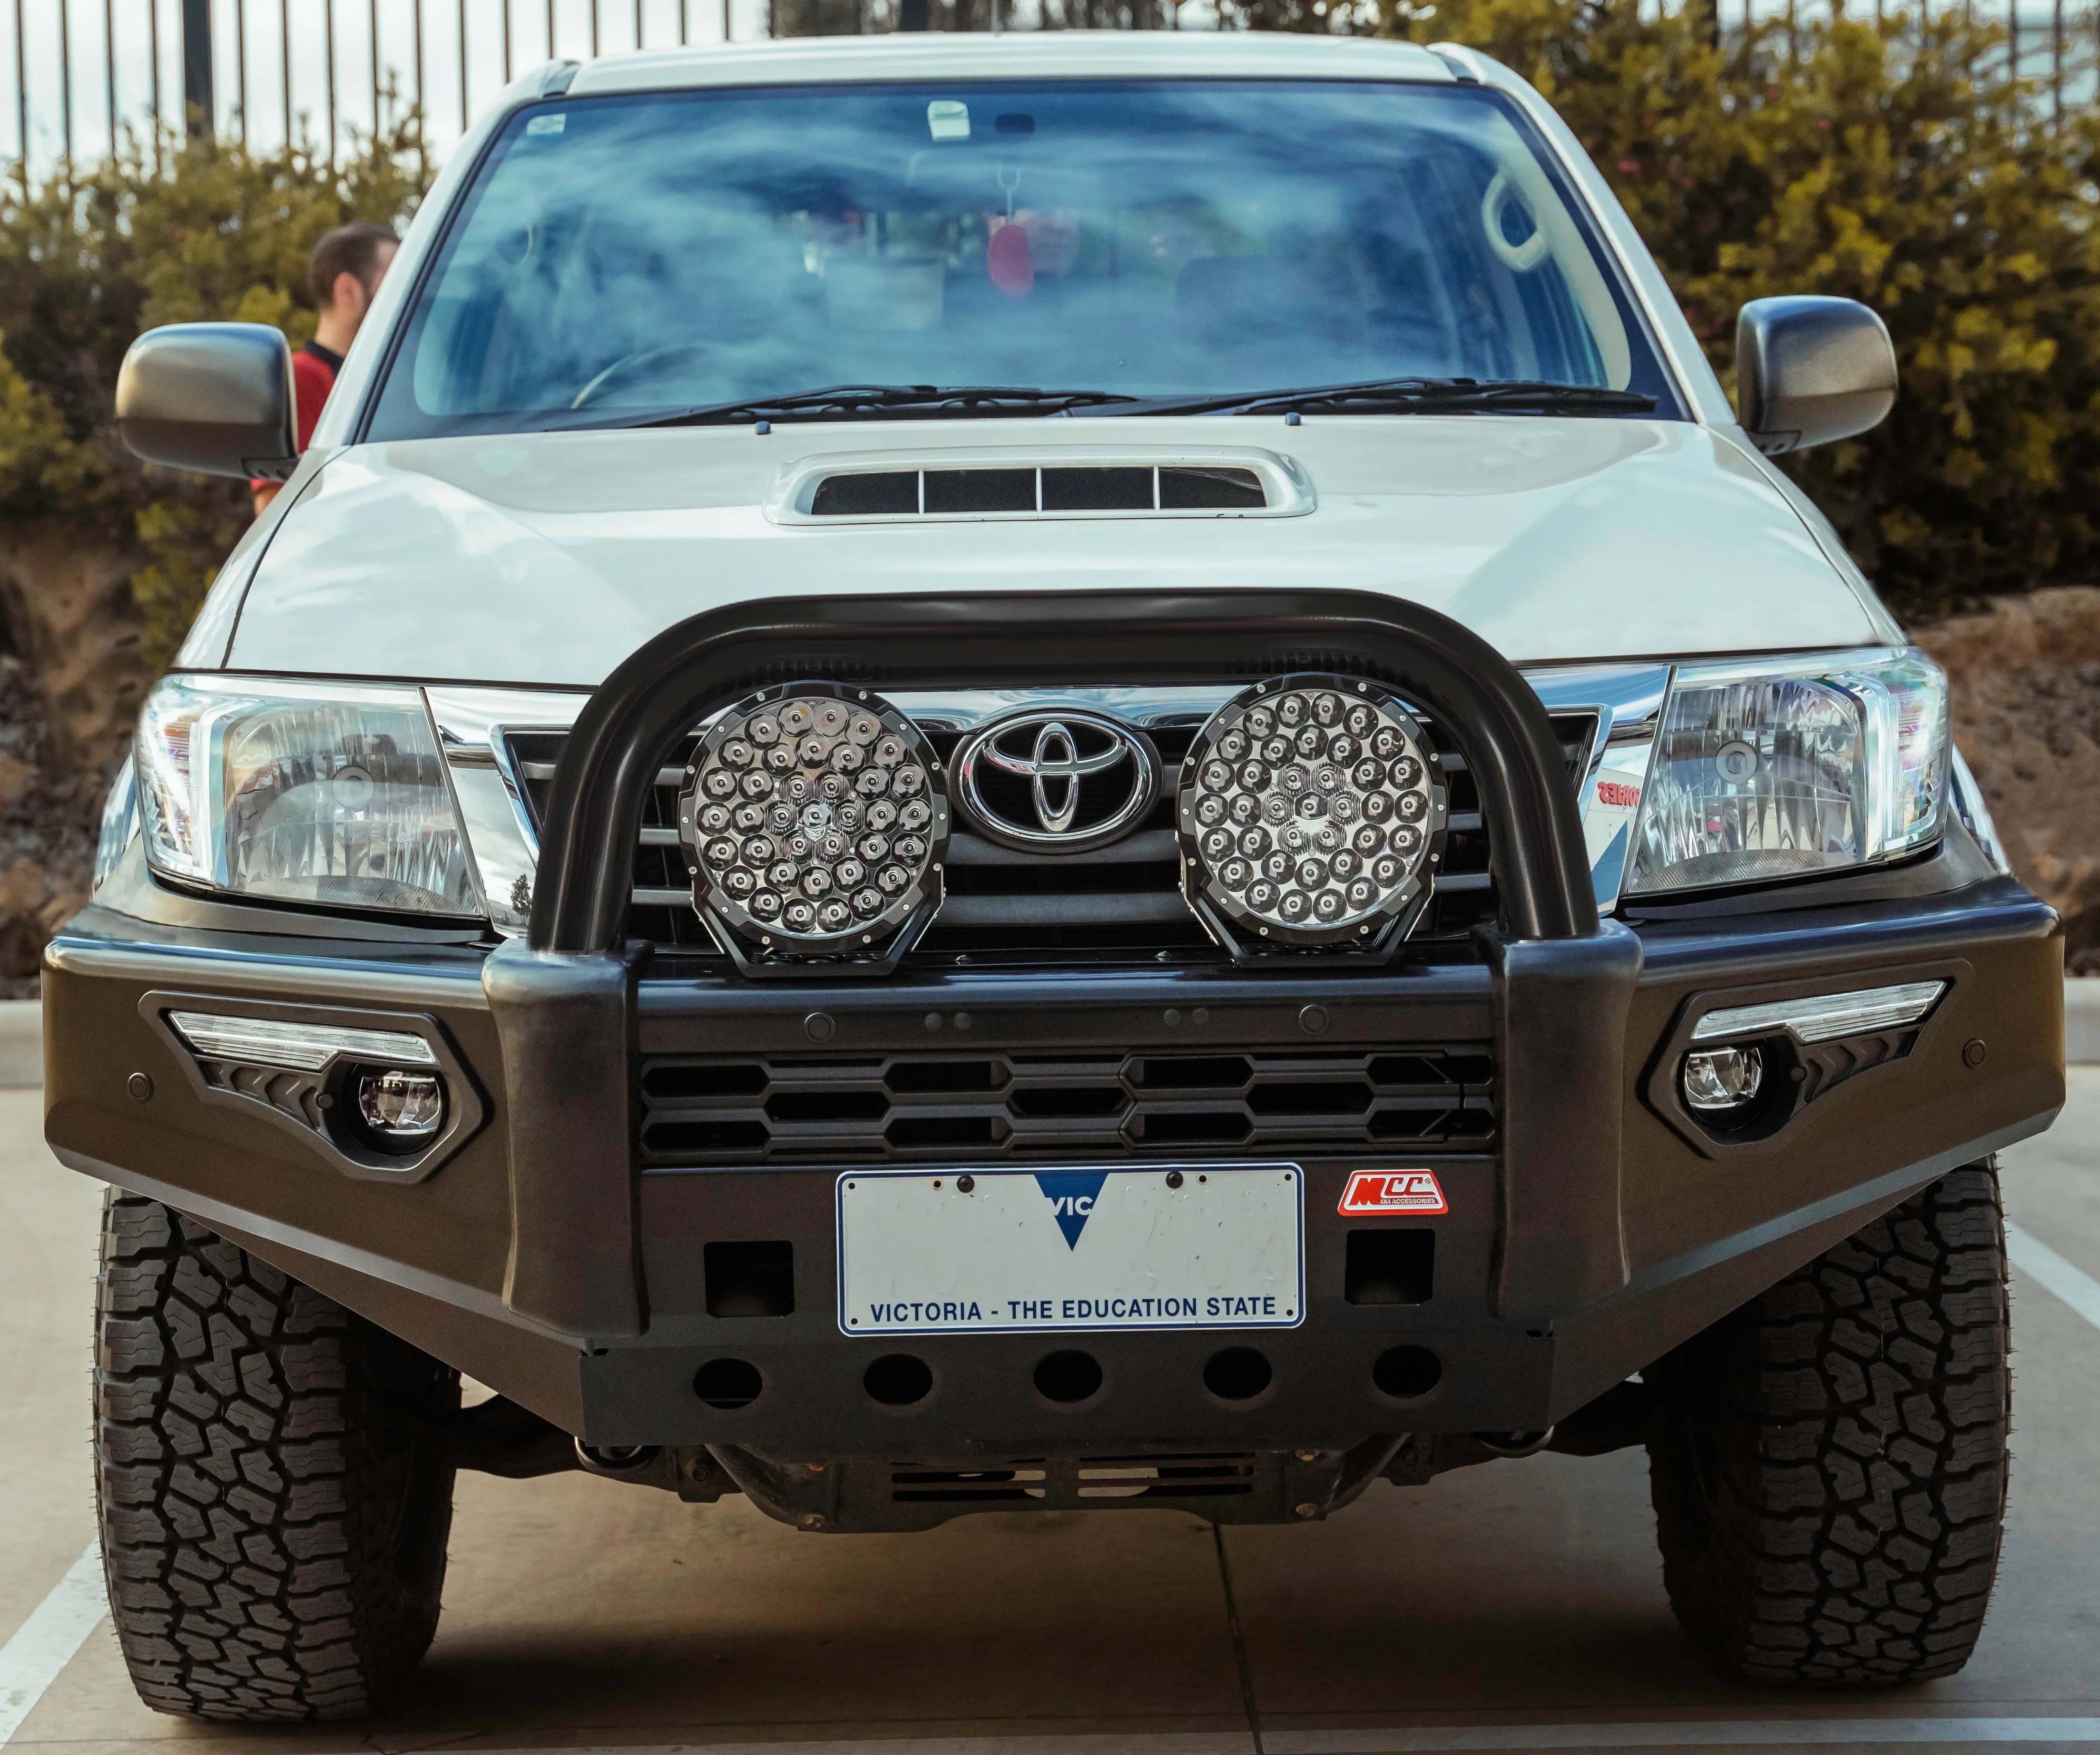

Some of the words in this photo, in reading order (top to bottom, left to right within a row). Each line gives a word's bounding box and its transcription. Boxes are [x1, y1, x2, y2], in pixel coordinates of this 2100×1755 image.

[1045, 1196, 1094, 1216] VIC
[870, 1302, 982, 1322] VICTORIA
[1007, 1301, 1053, 1319] THE
[1063, 1298, 1197, 1318] EDUCATION
[1207, 1296, 1276, 1316] STATE
